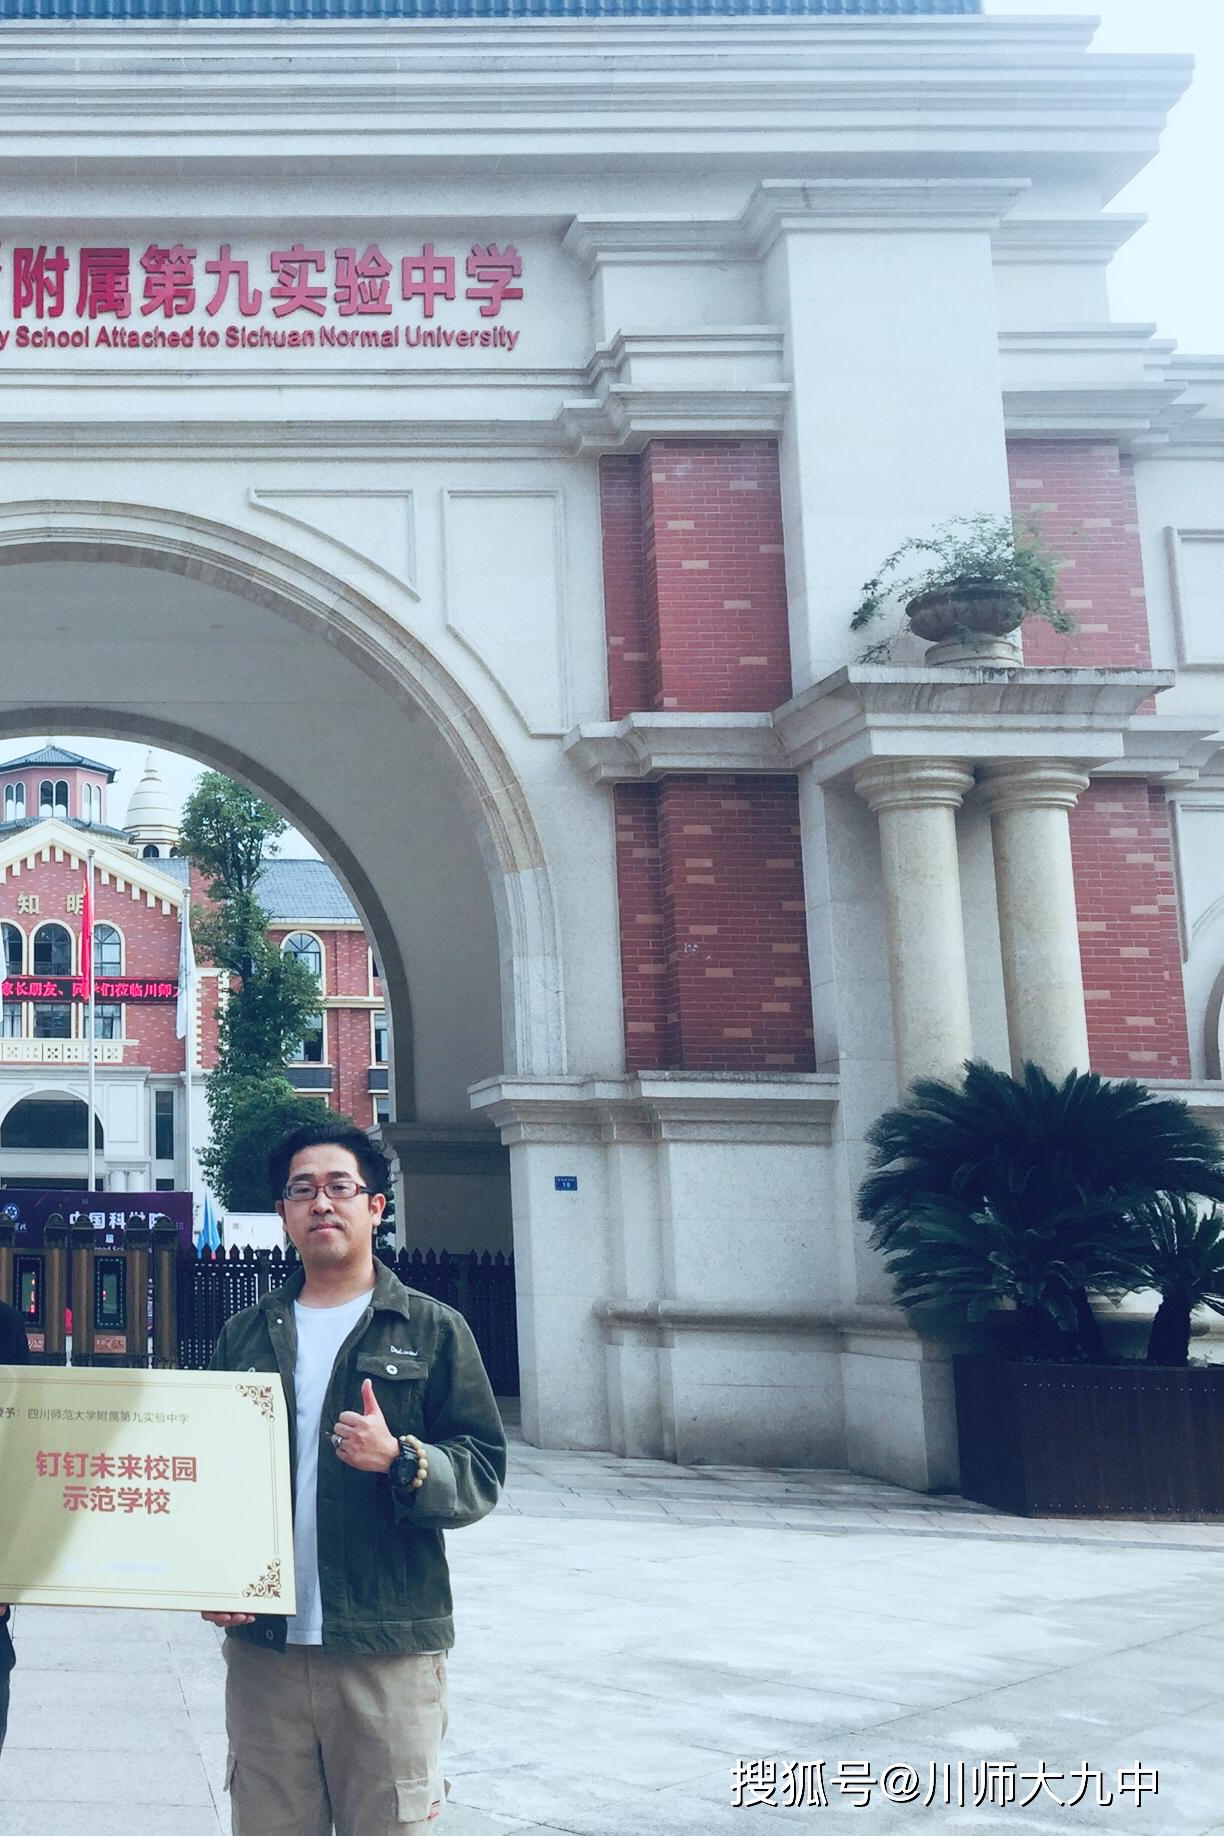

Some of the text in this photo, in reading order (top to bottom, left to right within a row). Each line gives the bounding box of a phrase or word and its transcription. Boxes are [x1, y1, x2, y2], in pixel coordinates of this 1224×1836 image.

[16, 325, 90, 349] School
[95, 326, 195, 349] Attached
[199, 329, 221, 348] to
[226, 326, 316, 349] Sichuan
[320, 326, 400, 349] Normal
[405, 327, 521, 351] University
[27, 1408, 190, 1425] 四川师范大学附属第九实验中学
[36, 1451, 197, 1482] 钉钉未来校园
[62, 1486, 170, 1514] 示范学校
